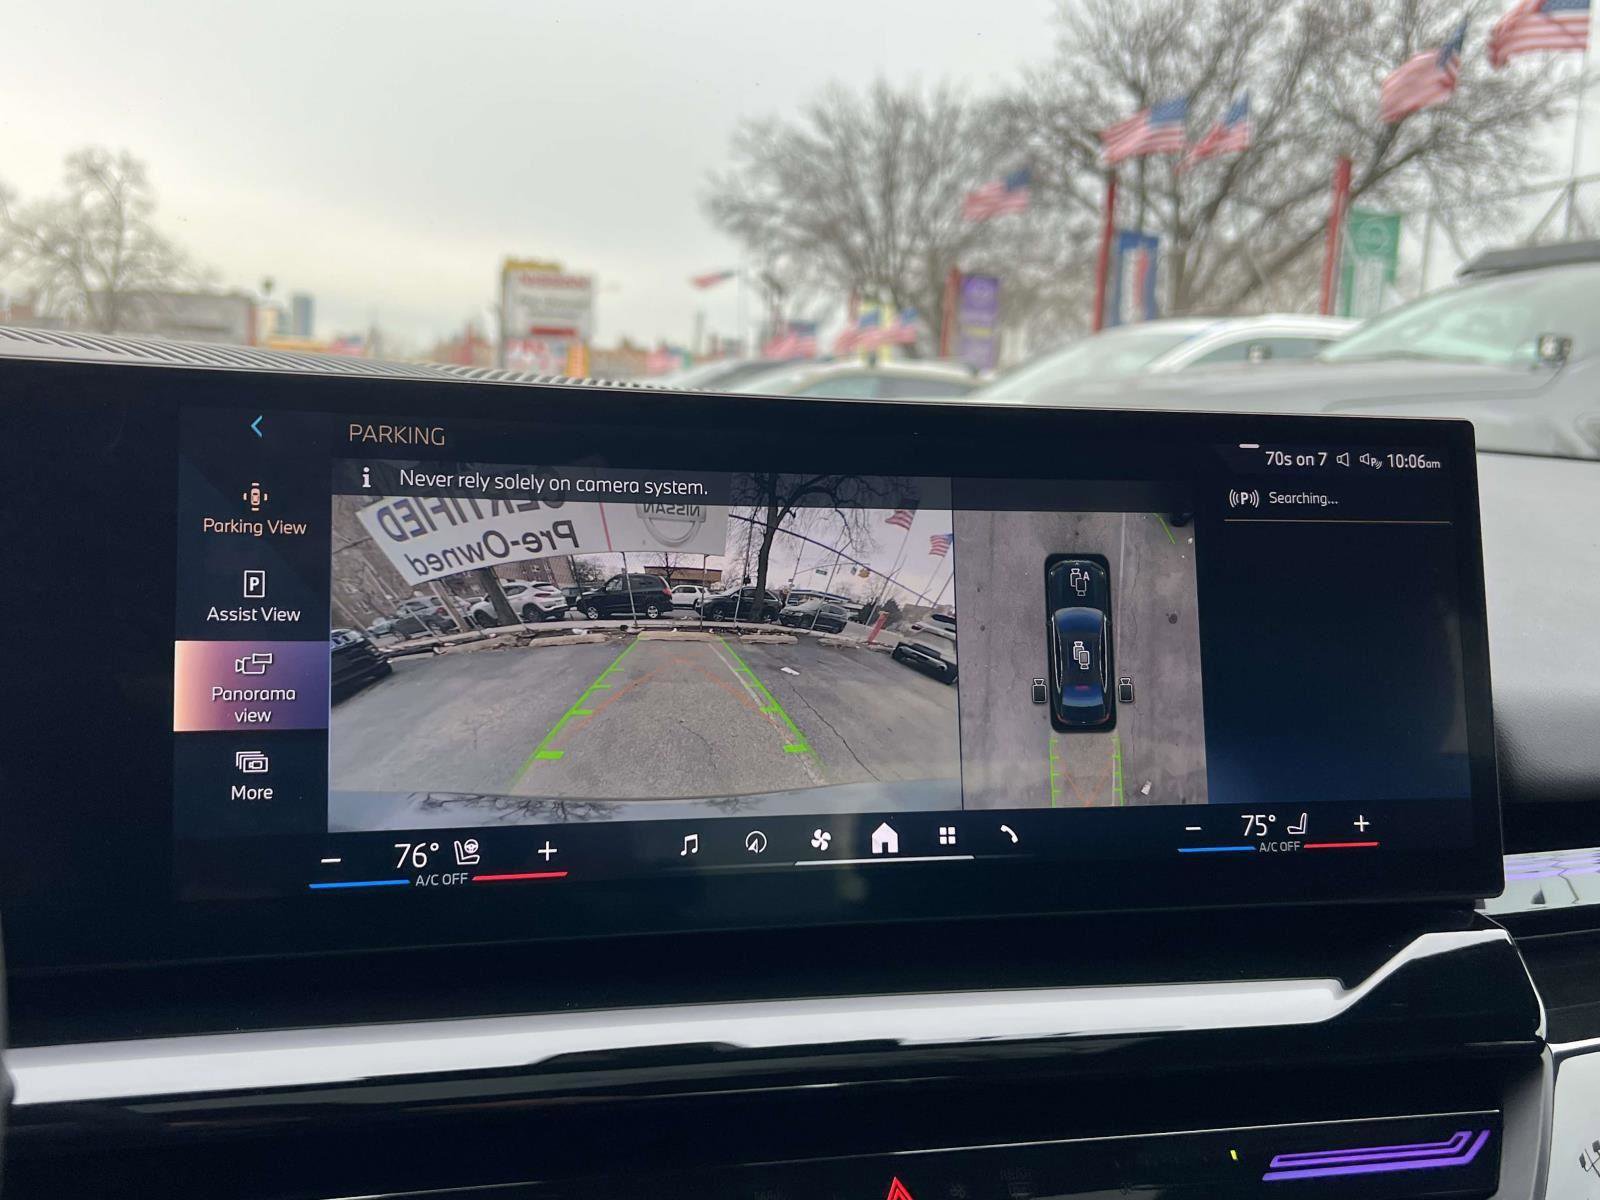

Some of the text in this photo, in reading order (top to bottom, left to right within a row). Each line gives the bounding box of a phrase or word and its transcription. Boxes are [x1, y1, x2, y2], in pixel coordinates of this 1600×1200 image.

[349, 423, 446, 446] PARKING
[1265, 451, 1328, 466] 70s on 7
[1386, 453, 1441, 469] 10:06am
[399, 469, 709, 497] Never rely solely on camera system.
[1268, 491, 1339, 507] Searching...
[203, 517, 307, 537] Parking View
[206, 606, 301, 622] Assist View
[211, 685, 296, 702] Panorama
[233, 707, 272, 723] view
[230, 784, 274, 800] More
[1241, 815, 1276, 836] 75°
[1259, 841, 1301, 853] A/C OFF
[394, 842, 440, 869] 76°
[415, 872, 469, 887] A/C OFF
